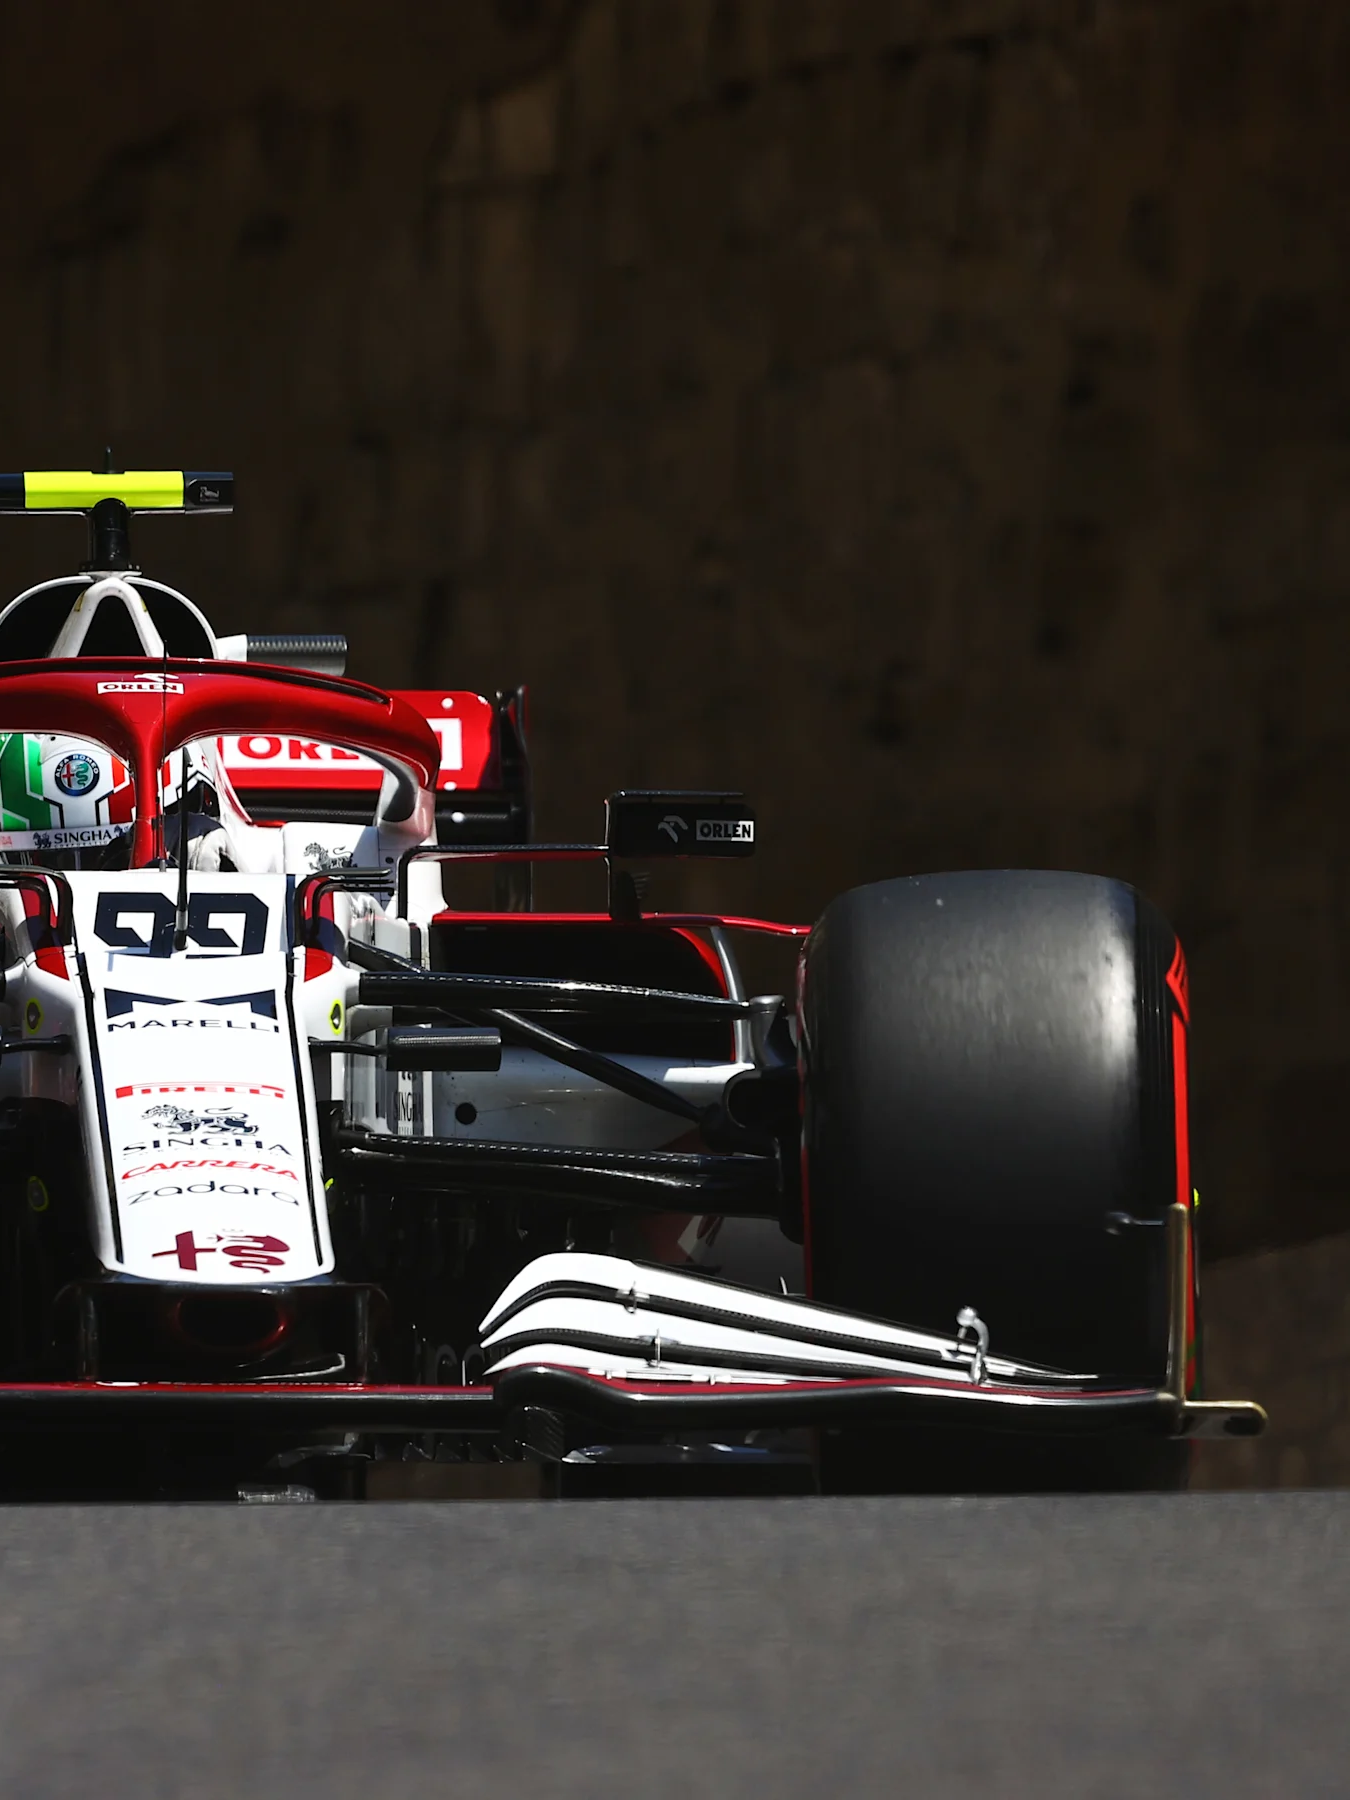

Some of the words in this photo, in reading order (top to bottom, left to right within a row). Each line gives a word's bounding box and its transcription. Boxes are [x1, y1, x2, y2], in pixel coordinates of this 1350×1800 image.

[103, 683, 177, 691] ORLEN
[55, 758, 70, 777] ALFA
[72, 755, 99, 775] ROMEO
[54, 829, 112, 844] SINGHA
[700, 823, 751, 838] ORLEN
[93, 892, 269, 959] 99
[107, 1019, 280, 1033] MARELLI
[115, 1081, 285, 1099] PIRELLI
[122, 1137, 293, 1156] SINGHA
[121, 1159, 299, 1181] CARRERA
[127, 1180, 300, 1207] zadara
